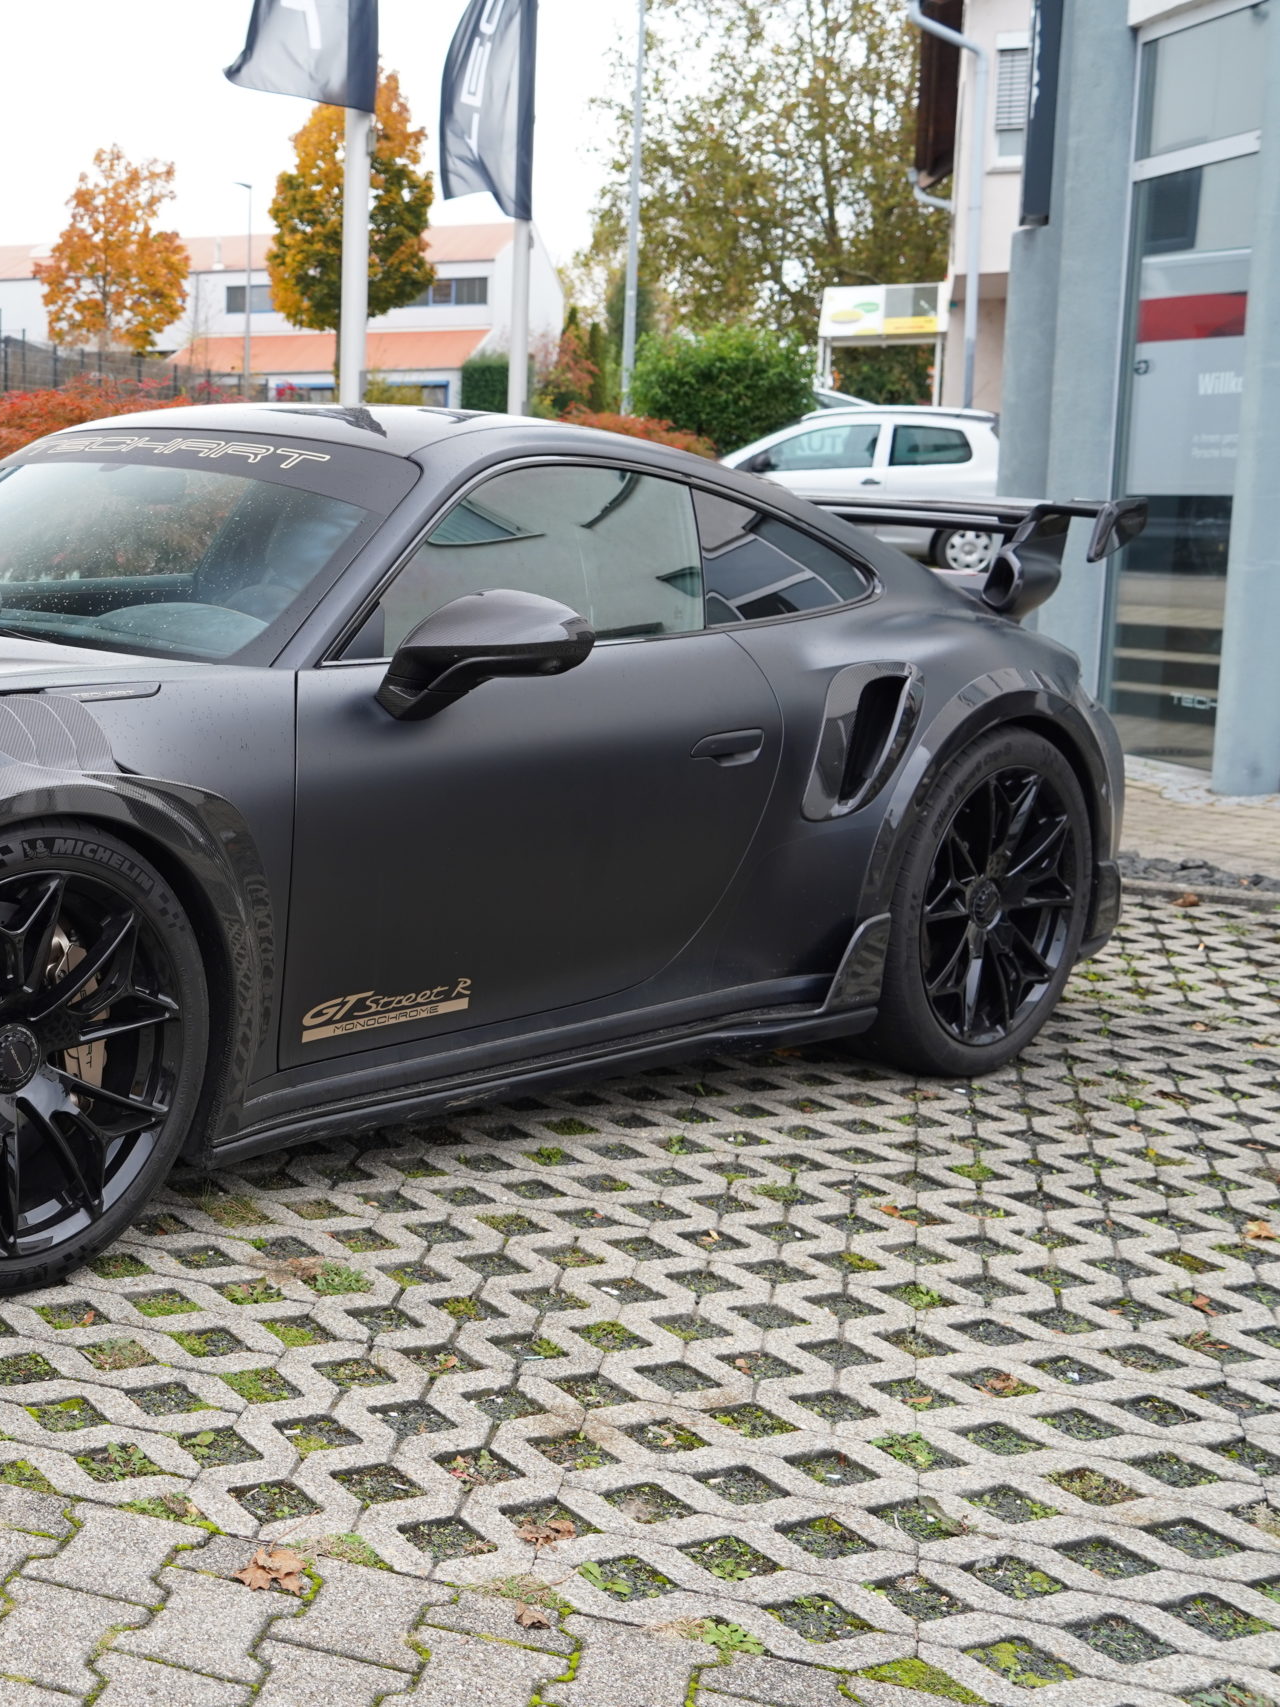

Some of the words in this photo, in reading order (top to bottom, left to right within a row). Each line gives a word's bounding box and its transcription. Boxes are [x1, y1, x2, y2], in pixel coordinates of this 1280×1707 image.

[24, 437, 331, 469] TECHART
[53, 838, 155, 890] MICHELIN
[302, 990, 375, 1027] GT
[353, 985, 449, 1016] Street
[452, 978, 472, 997] R
[332, 1005, 440, 1034] MONOCHROME
